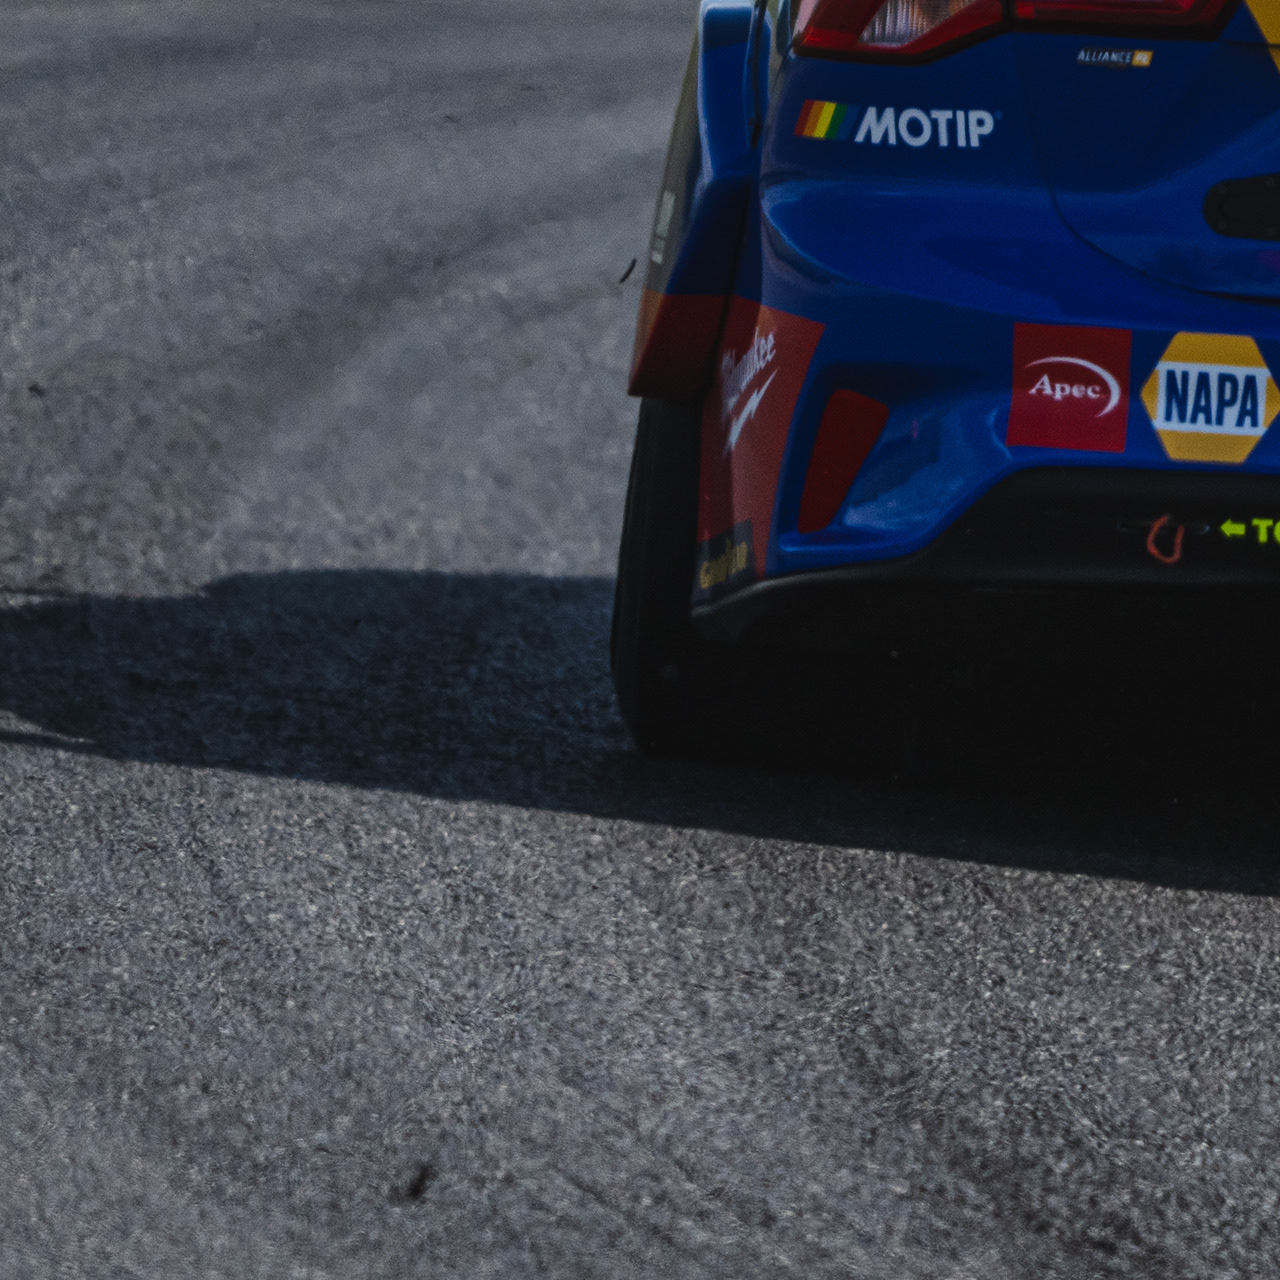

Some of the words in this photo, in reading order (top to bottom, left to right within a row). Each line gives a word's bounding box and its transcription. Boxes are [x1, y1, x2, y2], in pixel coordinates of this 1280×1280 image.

[854, 106, 995, 147] MOTIP
[1029, 372, 1102, 401] Apec
[1164, 368, 1259, 428] NAPA
